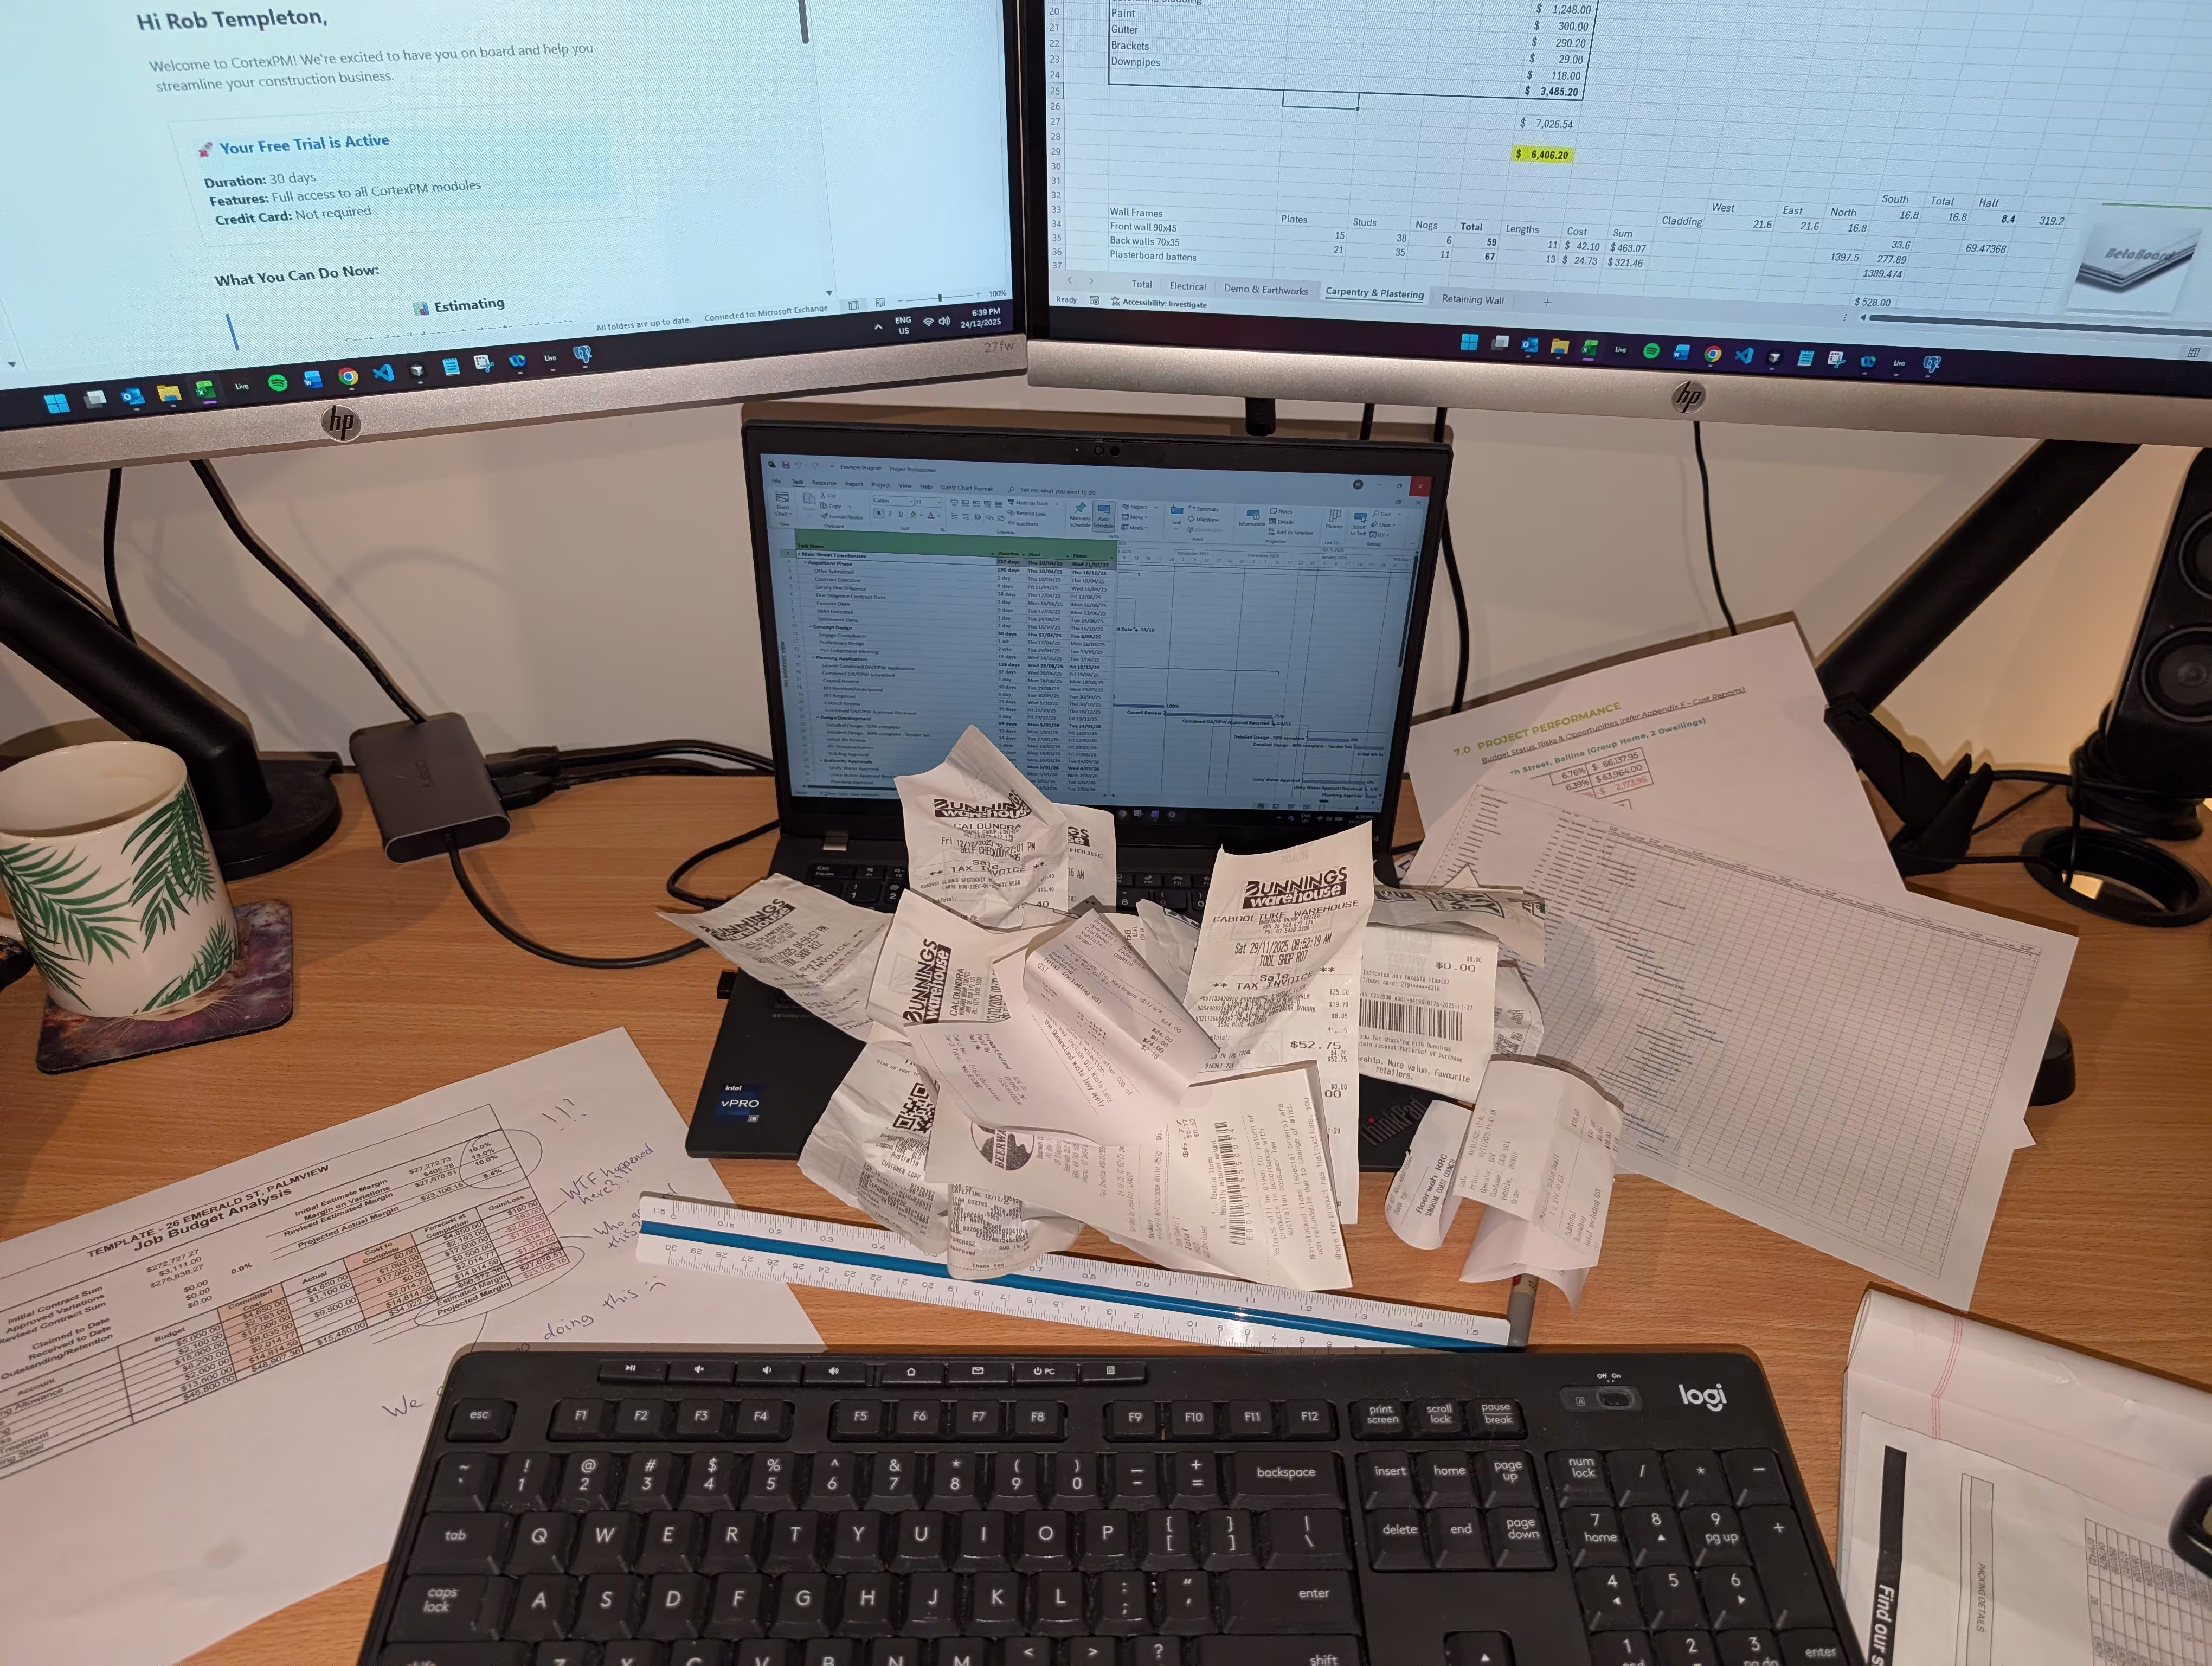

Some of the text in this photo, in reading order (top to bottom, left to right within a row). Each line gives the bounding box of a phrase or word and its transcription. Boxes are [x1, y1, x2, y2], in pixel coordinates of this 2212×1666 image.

[137, 9, 329, 31] Hi Rob Templeton,
[1111, 8, 1136, 19] Paint
[1110, 24, 1139, 35] Gutter
[1110, 40, 1149, 52] Brackets
[149, 42, 594, 74] Welcome to CortexPM! We're excited to have you on board and help you
[1110, 56, 1161, 69] Downpipes
[156, 69, 395, 92] streamline your construction business.
[1525, 85, 1579, 97] $ 3,485.20
[220, 133, 390, 156] Your Free Trial is Active
[1515, 147, 1570, 162] $ 6,406.20
[204, 174, 267, 189] Duration:
[288, 170, 317, 185] days
[209, 180, 481, 208] Features: Full access to all CortexPM modules
[215, 204, 372, 226] Credit Card: Not required
[1110, 206, 1163, 219] Wall Frames
[1712, 202, 1857, 218] West East North
[1110, 221, 1177, 234] Front wall 90x45
[1281, 214, 1540, 236] Plates Studs Nogs Total Lengths
[1662, 216, 1703, 228] Cladding
[1567, 226, 1633, 239] Cost Sum
[1110, 235, 1180, 248] Back walls 70x35
[1110, 249, 1198, 264] Plasterboard battens
[214, 265, 380, 287] What You Can Do Now:
[1862, 267, 1903, 280] 1389.474
[1169, 280, 1207, 292] Electrical
[1224, 283, 1309, 297] Demo & Earthworks
[1326, 286, 1424, 302] Carpentry & Plastering
[434, 297, 505, 315] Estimating
[1442, 292, 1504, 306] Retaining Wall
[972, 307, 1001, 316] 6:39 PM
[895, 315, 911, 325] ENG
[960, 317, 1002, 329] 24/12/2025
[898, 326, 910, 335] US
[983, 339, 1015, 354] 27fw
[1675, 381, 1702, 413] hp
[328, 405, 355, 441] hp
[1453, 702, 1622, 758] 7.0 PROJECT PERFORMANCE
[1602, 751, 1639, 768] 66,137.95
[954, 823, 1021, 831] CALOUNDRA
[1244, 866, 1347, 896] BUNNINGS
[1250, 883, 1341, 907] warehouse
[1213, 899, 1359, 922] CABOOLTURE WAREHOUSE
[1235, 932, 1333, 956] Sat 29/11/2025 08:52:19 AM
[1259, 950, 1308, 967] TOOL SHOP R07
[1436, 961, 1476, 972] $0.00
[903, 938, 938, 1023] BUNNINGS
[926, 949, 950, 1023] warehouse
[949, 968, 964, 1017] CALOUNDRA
[1290, 1040, 1341, 1050] $52.75
[1375, 1065, 1413, 1080] retailers.
[1435, 1068, 1470, 1084] Favourite
[721, 1099, 760, 1108] vPRO
[560, 1143, 655, 1202] WTF happened
[1415, 1153, 1448, 1214] Beerwah RRC
[86, 1228, 156, 1259] TEMPLATE
[166, 1219, 181, 1231] 26
[183, 1198, 243, 1225] EMERALD
[245, 1189, 266, 1203] ST,
[267, 1164, 330, 1194] PALMVIEW
[133, 1187, 292, 1253] Job Budget Analysis
[1136, 1280, 1150, 1289] 0.9
[543, 1287, 640, 1341] doing this
[382, 1393, 425, 1418] We
[1678, 1383, 1727, 1412] logi
[470, 1409, 489, 1420] esc
[1257, 1466, 1316, 1482] backspace
[445, 1528, 467, 1541] tab
[1382, 1524, 1419, 1535] delete
[1298, 1588, 1330, 1599] enter
[1976, 1562, 1987, 1632] PACKING DETAILS
[1873, 1584, 1895, 1654] Find our
